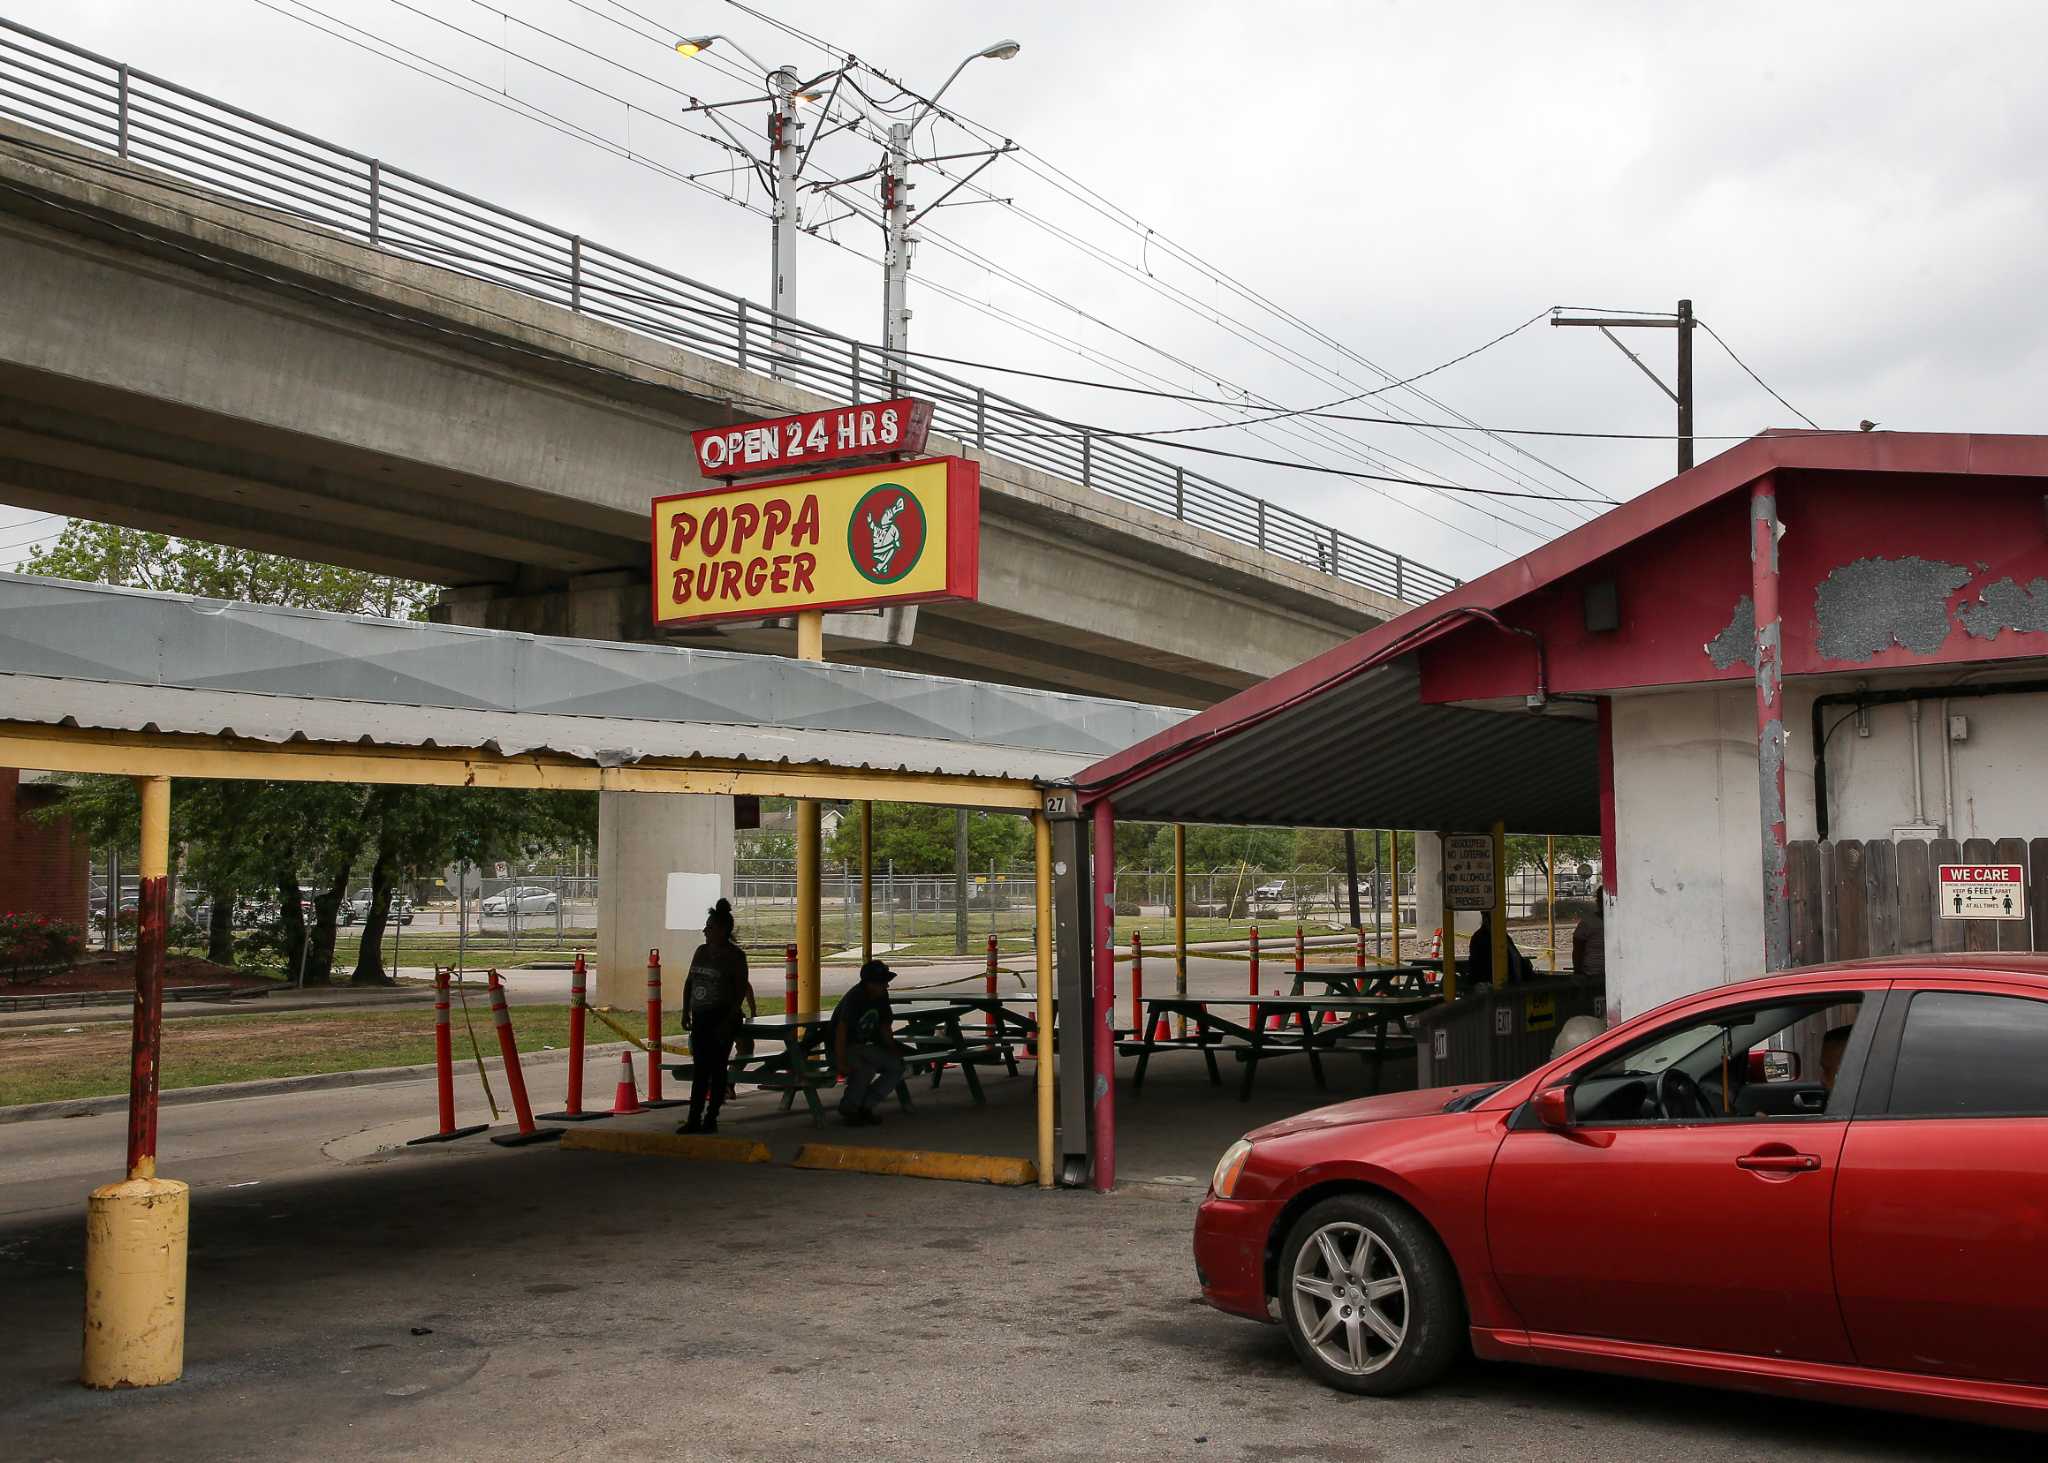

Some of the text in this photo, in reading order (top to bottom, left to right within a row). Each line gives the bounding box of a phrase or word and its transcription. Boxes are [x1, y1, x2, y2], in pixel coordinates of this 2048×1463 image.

[701, 409, 898, 468] OPEN 24 HRS
[670, 494, 820, 561] POPPA
[672, 552, 817, 605] BURGER
[1048, 798, 1063, 811] 27
[1951, 869, 2009, 881] WE CARE
